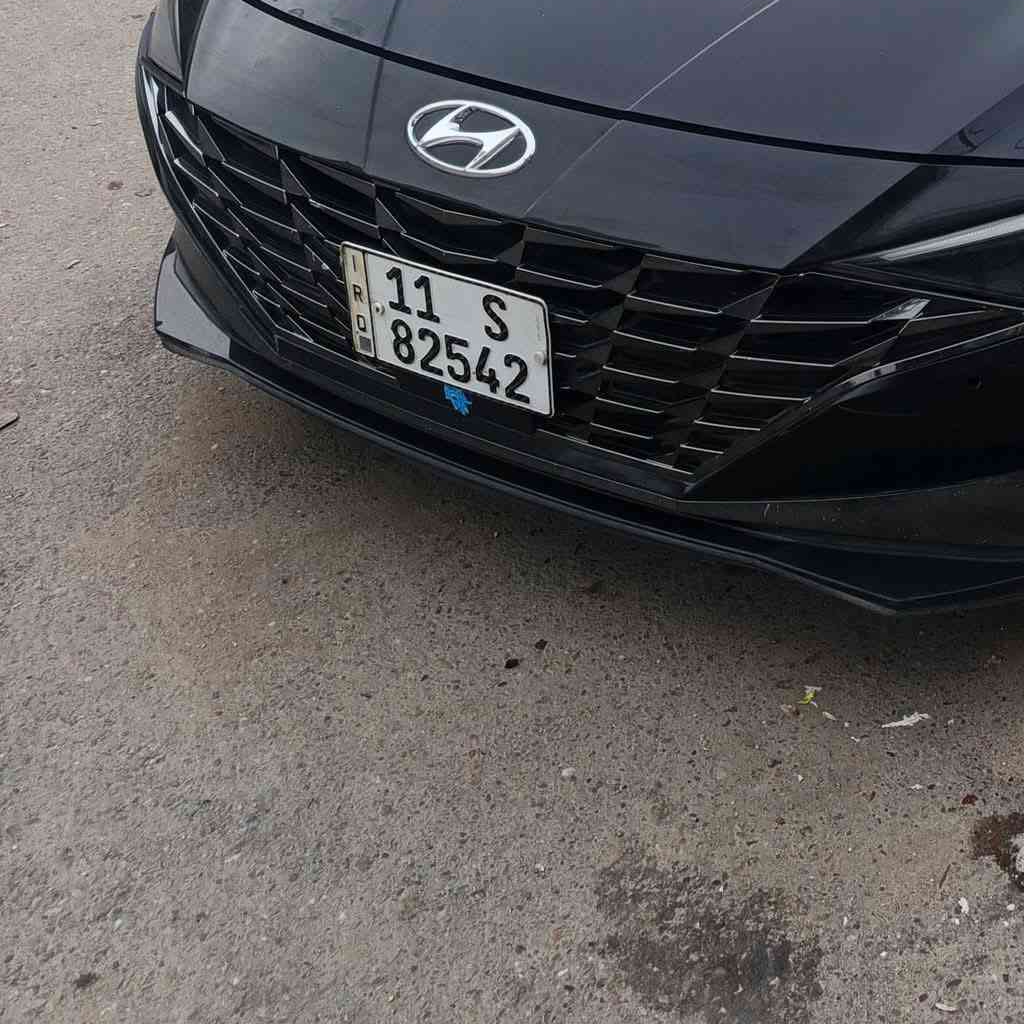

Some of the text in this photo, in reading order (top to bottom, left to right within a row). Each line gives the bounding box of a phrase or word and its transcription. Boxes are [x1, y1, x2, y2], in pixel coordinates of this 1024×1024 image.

[385, 266, 509, 341] 11 S
[391, 318, 530, 404] 82542
